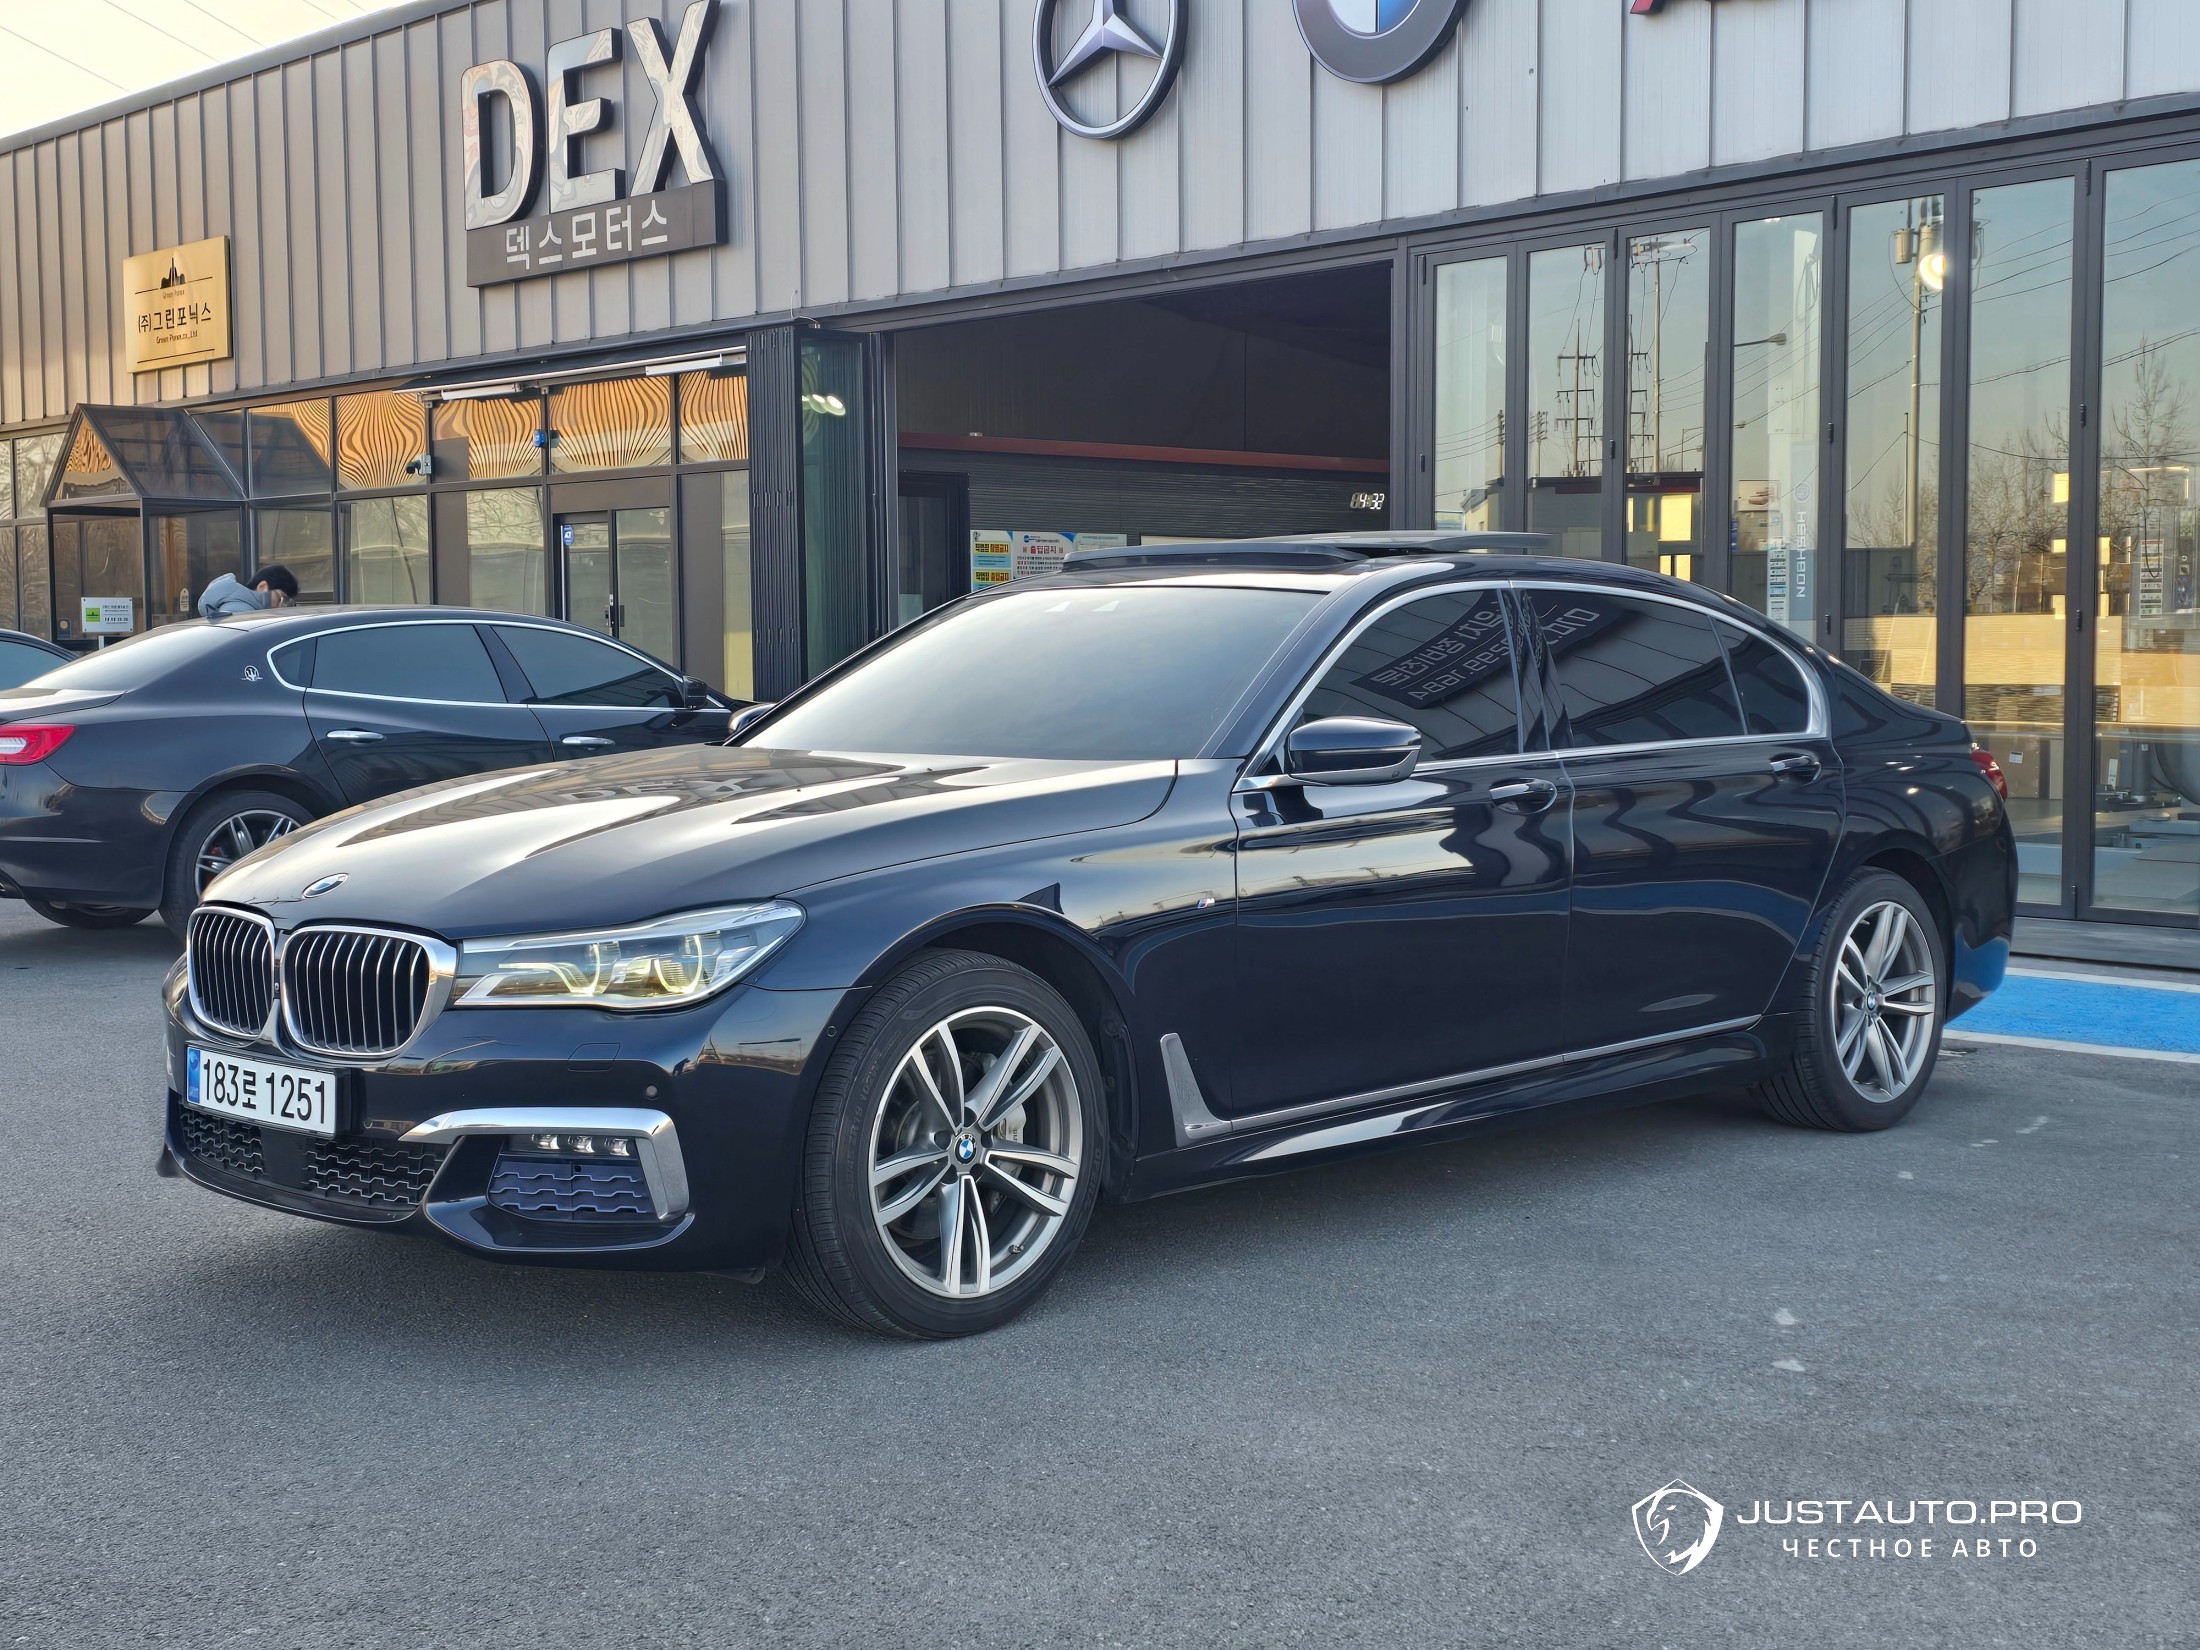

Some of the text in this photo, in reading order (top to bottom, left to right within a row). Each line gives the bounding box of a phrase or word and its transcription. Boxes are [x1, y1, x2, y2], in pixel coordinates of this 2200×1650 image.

[461, 0, 719, 231] DEX
[505, 199, 669, 270] 덱스모터스
[138, 302, 212, 334] (주)그린포닉스
[1796, 510, 1807, 598] HESHBON
[203, 1058, 326, 1125] 183로 1251
